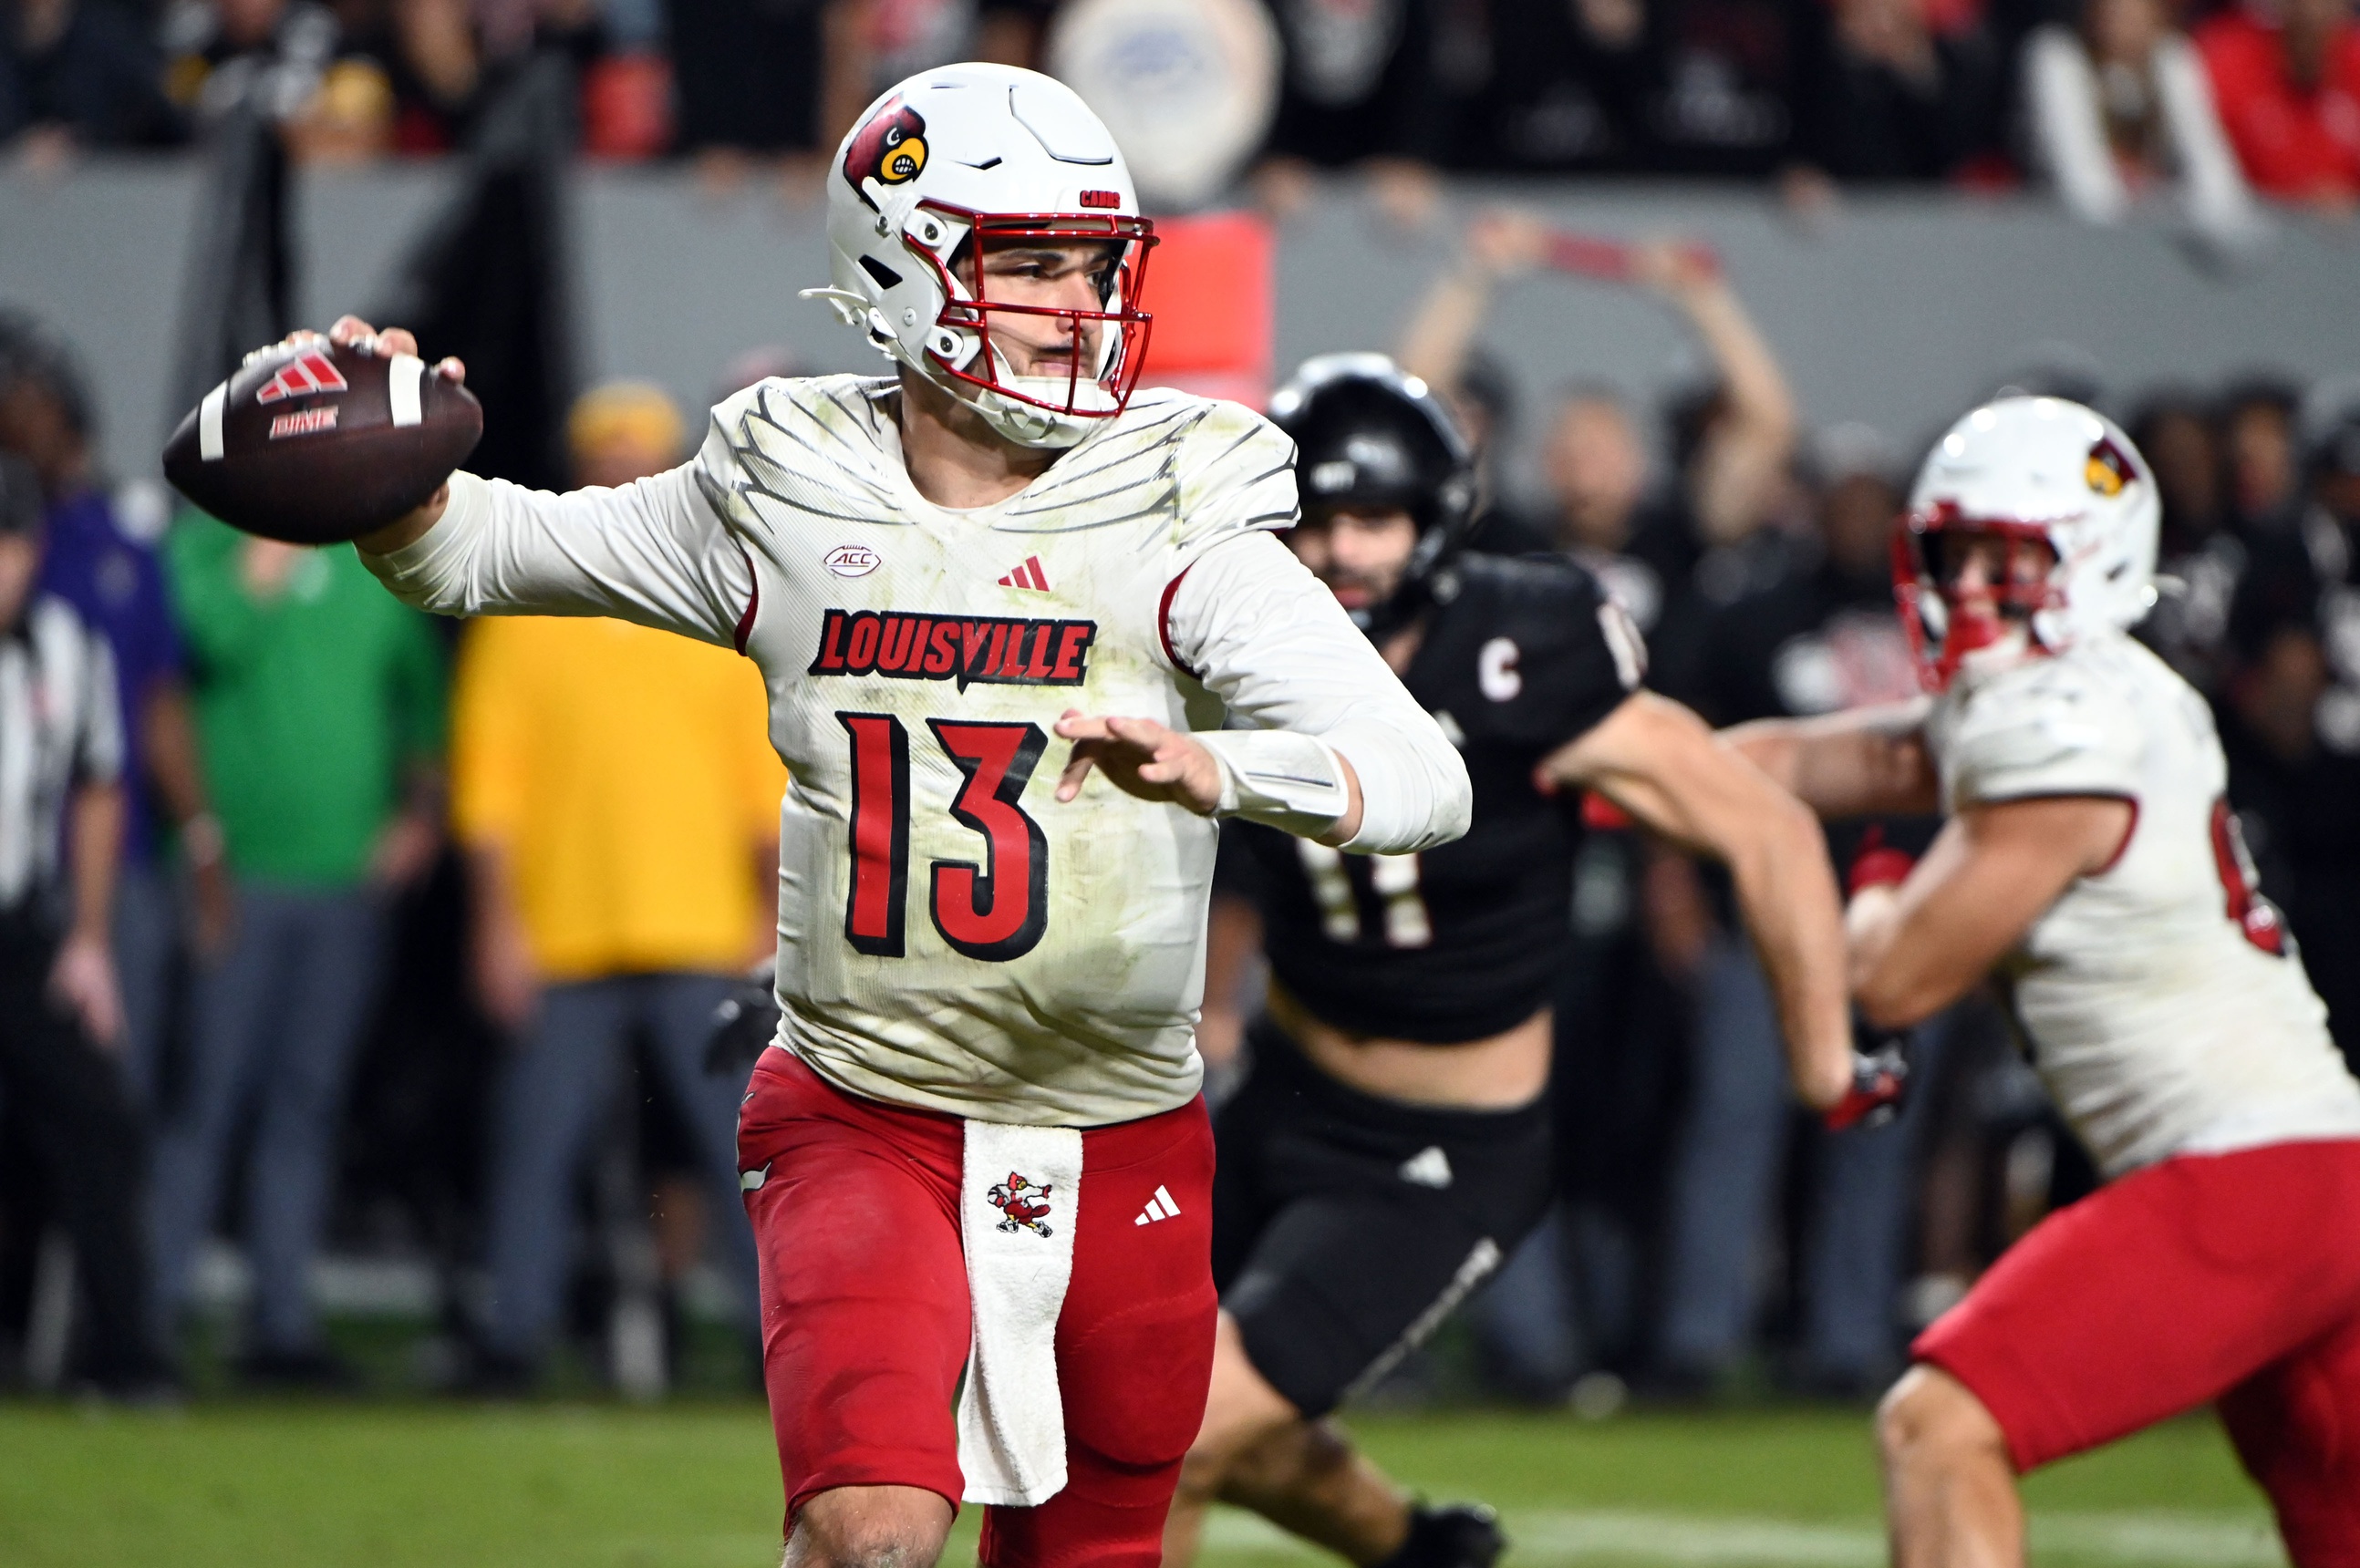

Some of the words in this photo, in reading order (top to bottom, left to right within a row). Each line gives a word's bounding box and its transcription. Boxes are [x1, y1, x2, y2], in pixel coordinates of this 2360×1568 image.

[269, 405, 338, 440] DIME
[833, 552, 873, 564] ACC
[808, 608, 1098, 695] LOUISVILLE
[1478, 637, 1522, 702] C
[834, 710, 1049, 963] 13
